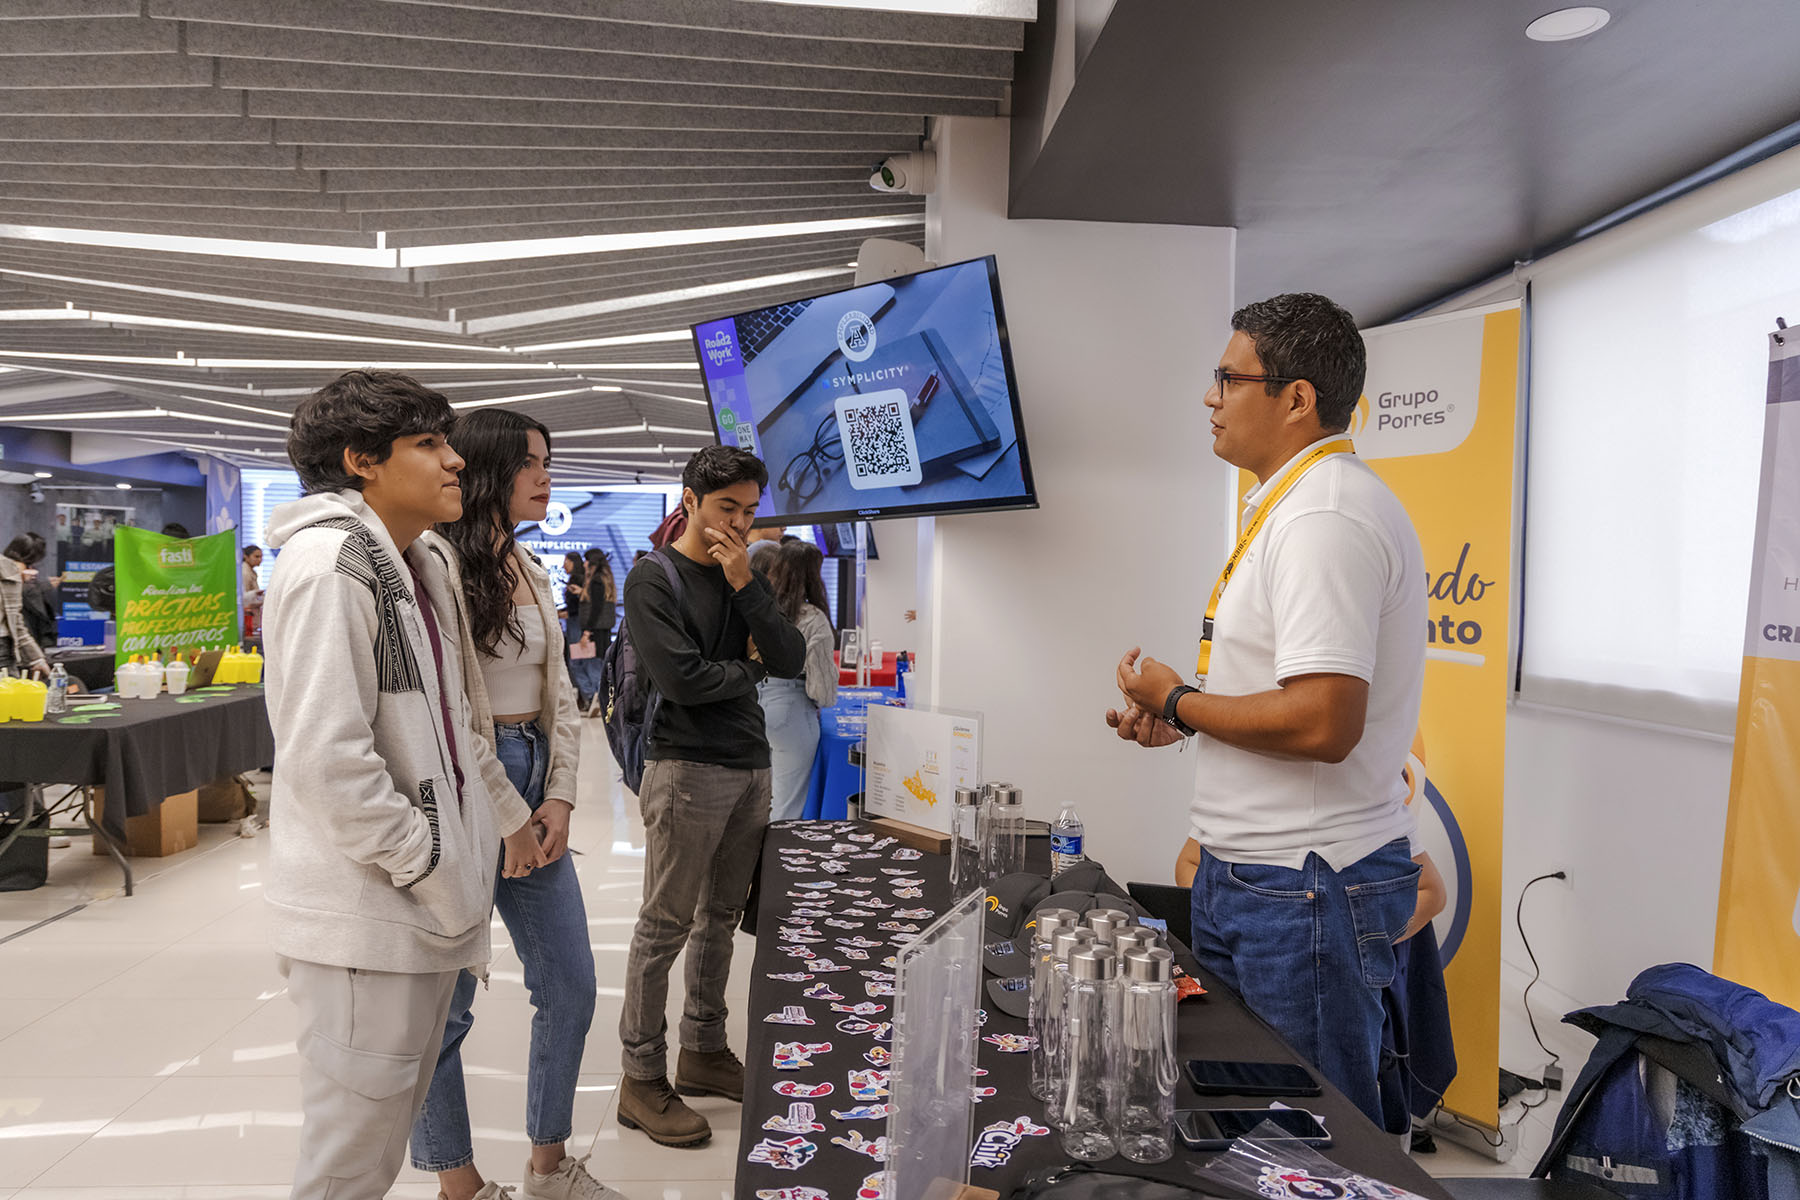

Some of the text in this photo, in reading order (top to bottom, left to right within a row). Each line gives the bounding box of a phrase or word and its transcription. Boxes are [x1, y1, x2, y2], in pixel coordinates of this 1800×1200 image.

[705, 334, 732, 349] Road2
[707, 347, 732, 361] Work
[833, 366, 904, 388] SYMPLICITY
[1379, 390, 1438, 409] Grupo
[721, 414, 733, 424] GO
[1379, 411, 1445, 431] Porres
[737, 424, 751, 434] ONE
[739, 434, 753, 443] WAY
[1426, 542, 1495, 605] do
[123, 592, 226, 618] PRÁCTICAS
[122, 626, 229, 652] CON NOSOTROS
